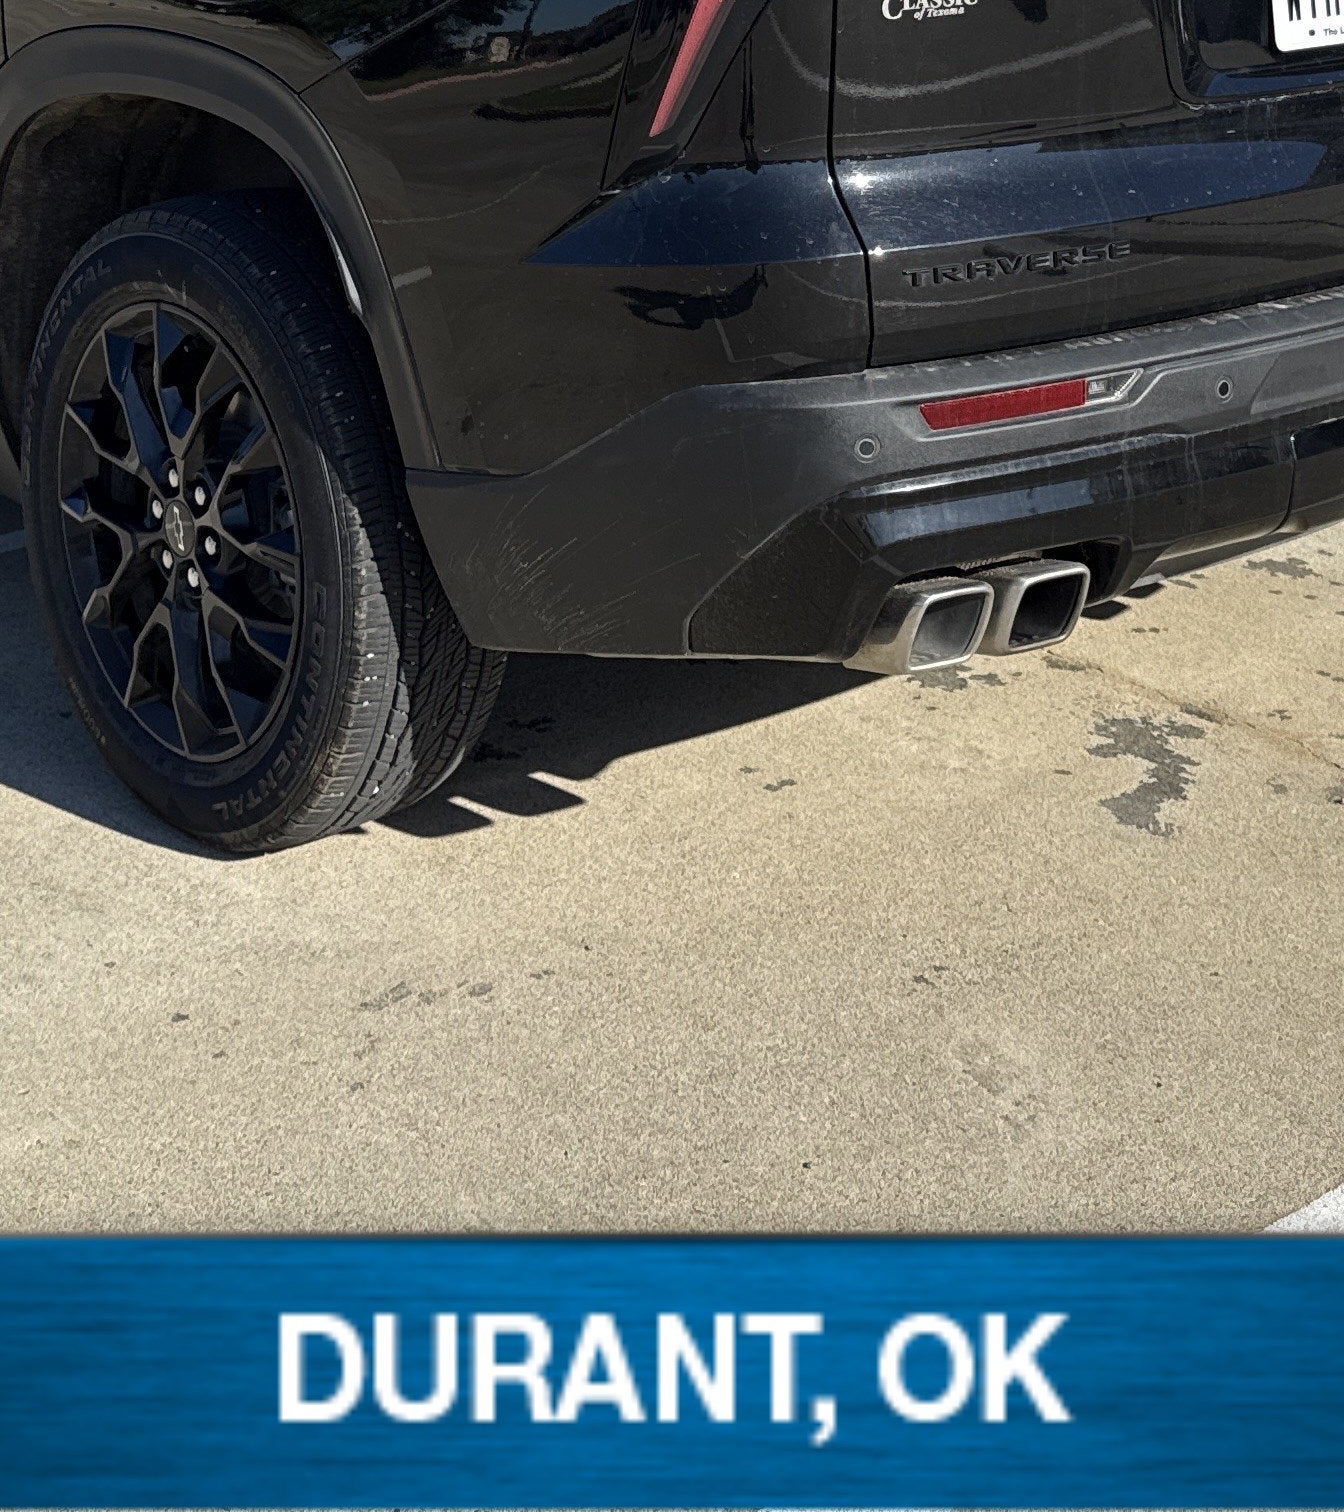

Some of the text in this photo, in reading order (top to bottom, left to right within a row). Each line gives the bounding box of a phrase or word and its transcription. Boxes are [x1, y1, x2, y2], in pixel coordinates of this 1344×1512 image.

[913, 7, 926, 21] of
[1323, 28, 1338, 37] The
[902, 240, 1132, 288] TRAVERSE
[211, 581, 328, 821] CONTINENTAL
